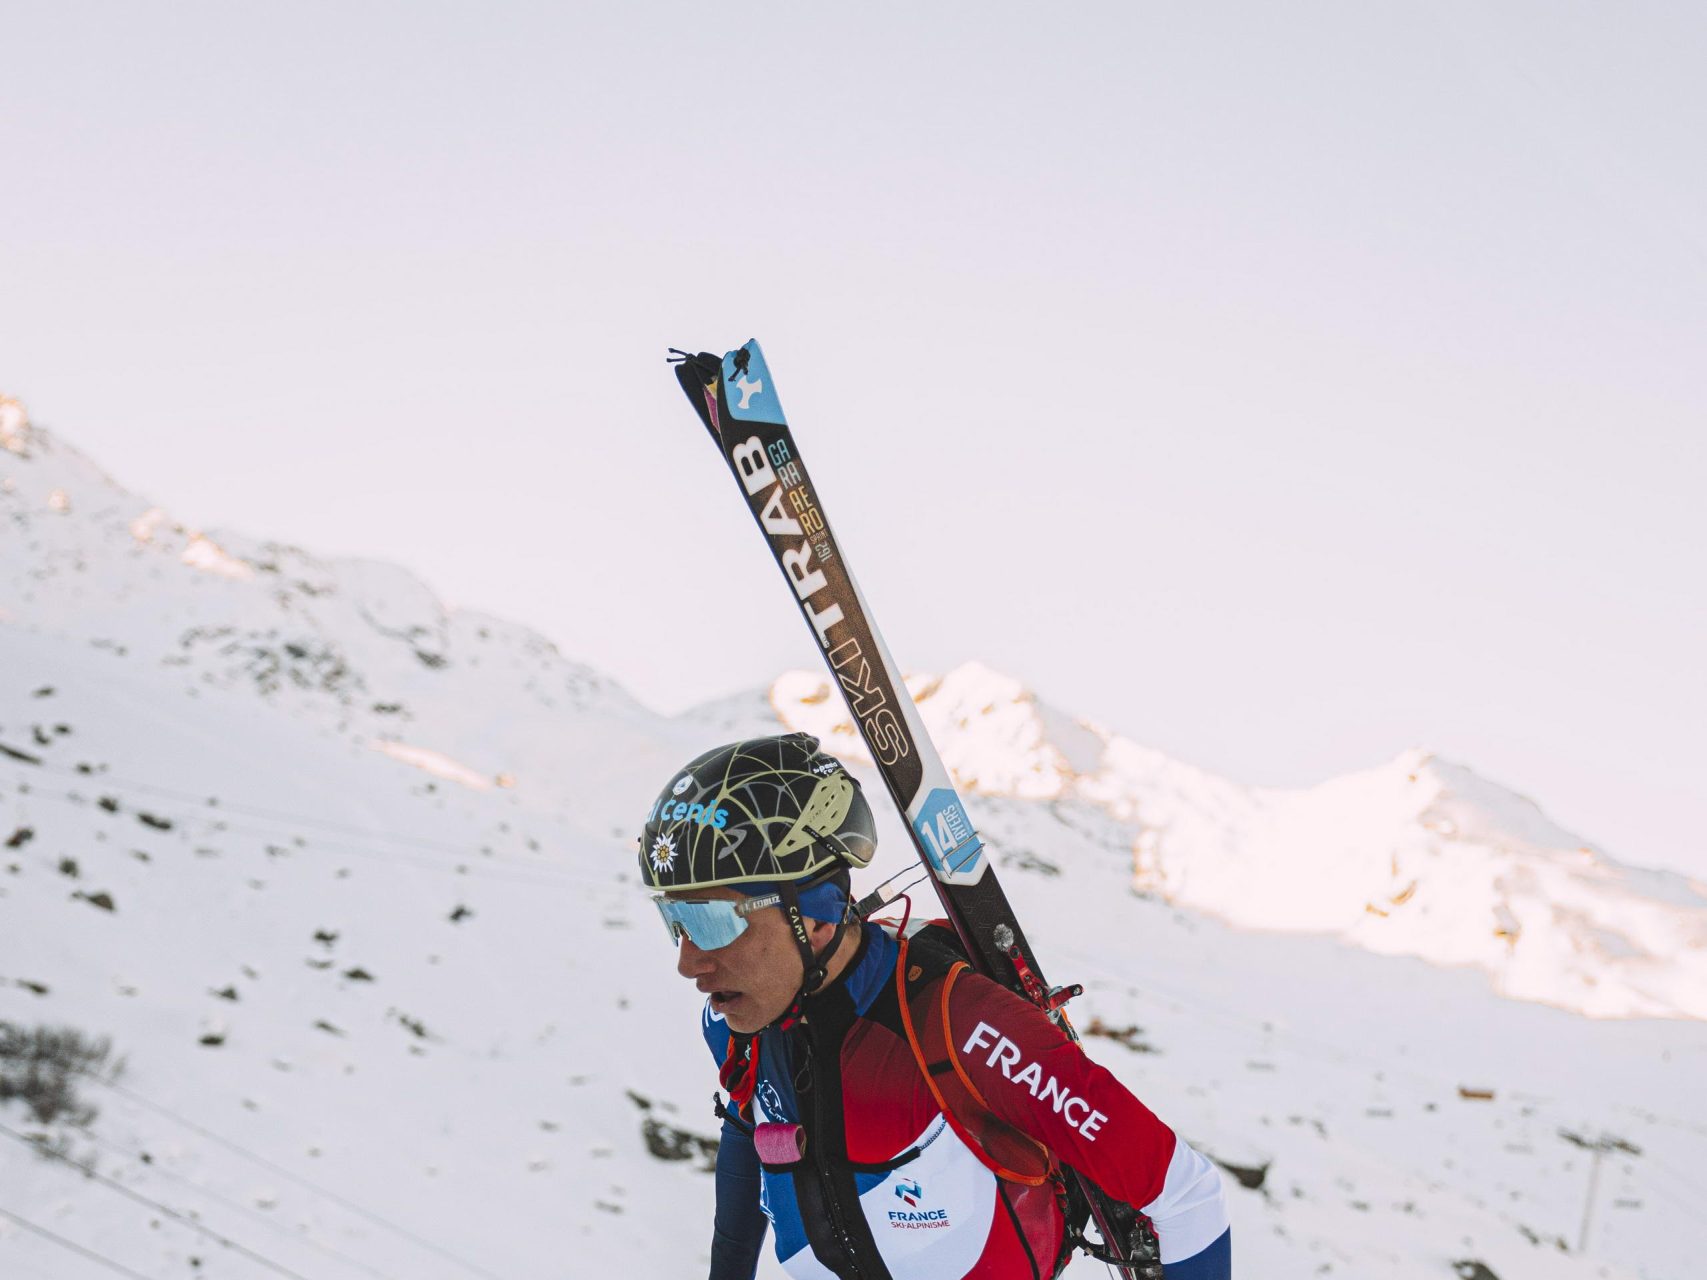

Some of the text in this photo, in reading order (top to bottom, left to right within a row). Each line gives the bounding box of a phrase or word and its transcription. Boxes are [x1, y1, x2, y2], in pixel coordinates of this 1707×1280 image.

[768, 439, 791, 467] GA
[777, 461, 802, 489] RA
[788, 485, 813, 514] AE
[799, 507, 825, 536] RO
[661, 799, 729, 829] cenis
[943, 804, 969, 841] AYERS
[921, 812, 959, 873] 14
[790, 906, 807, 944] CAMP
[963, 1021, 1109, 1142] FRANCE
[888, 1209, 948, 1221] FRANCE
[891, 1220, 951, 1230] SKI-ALPINISME
